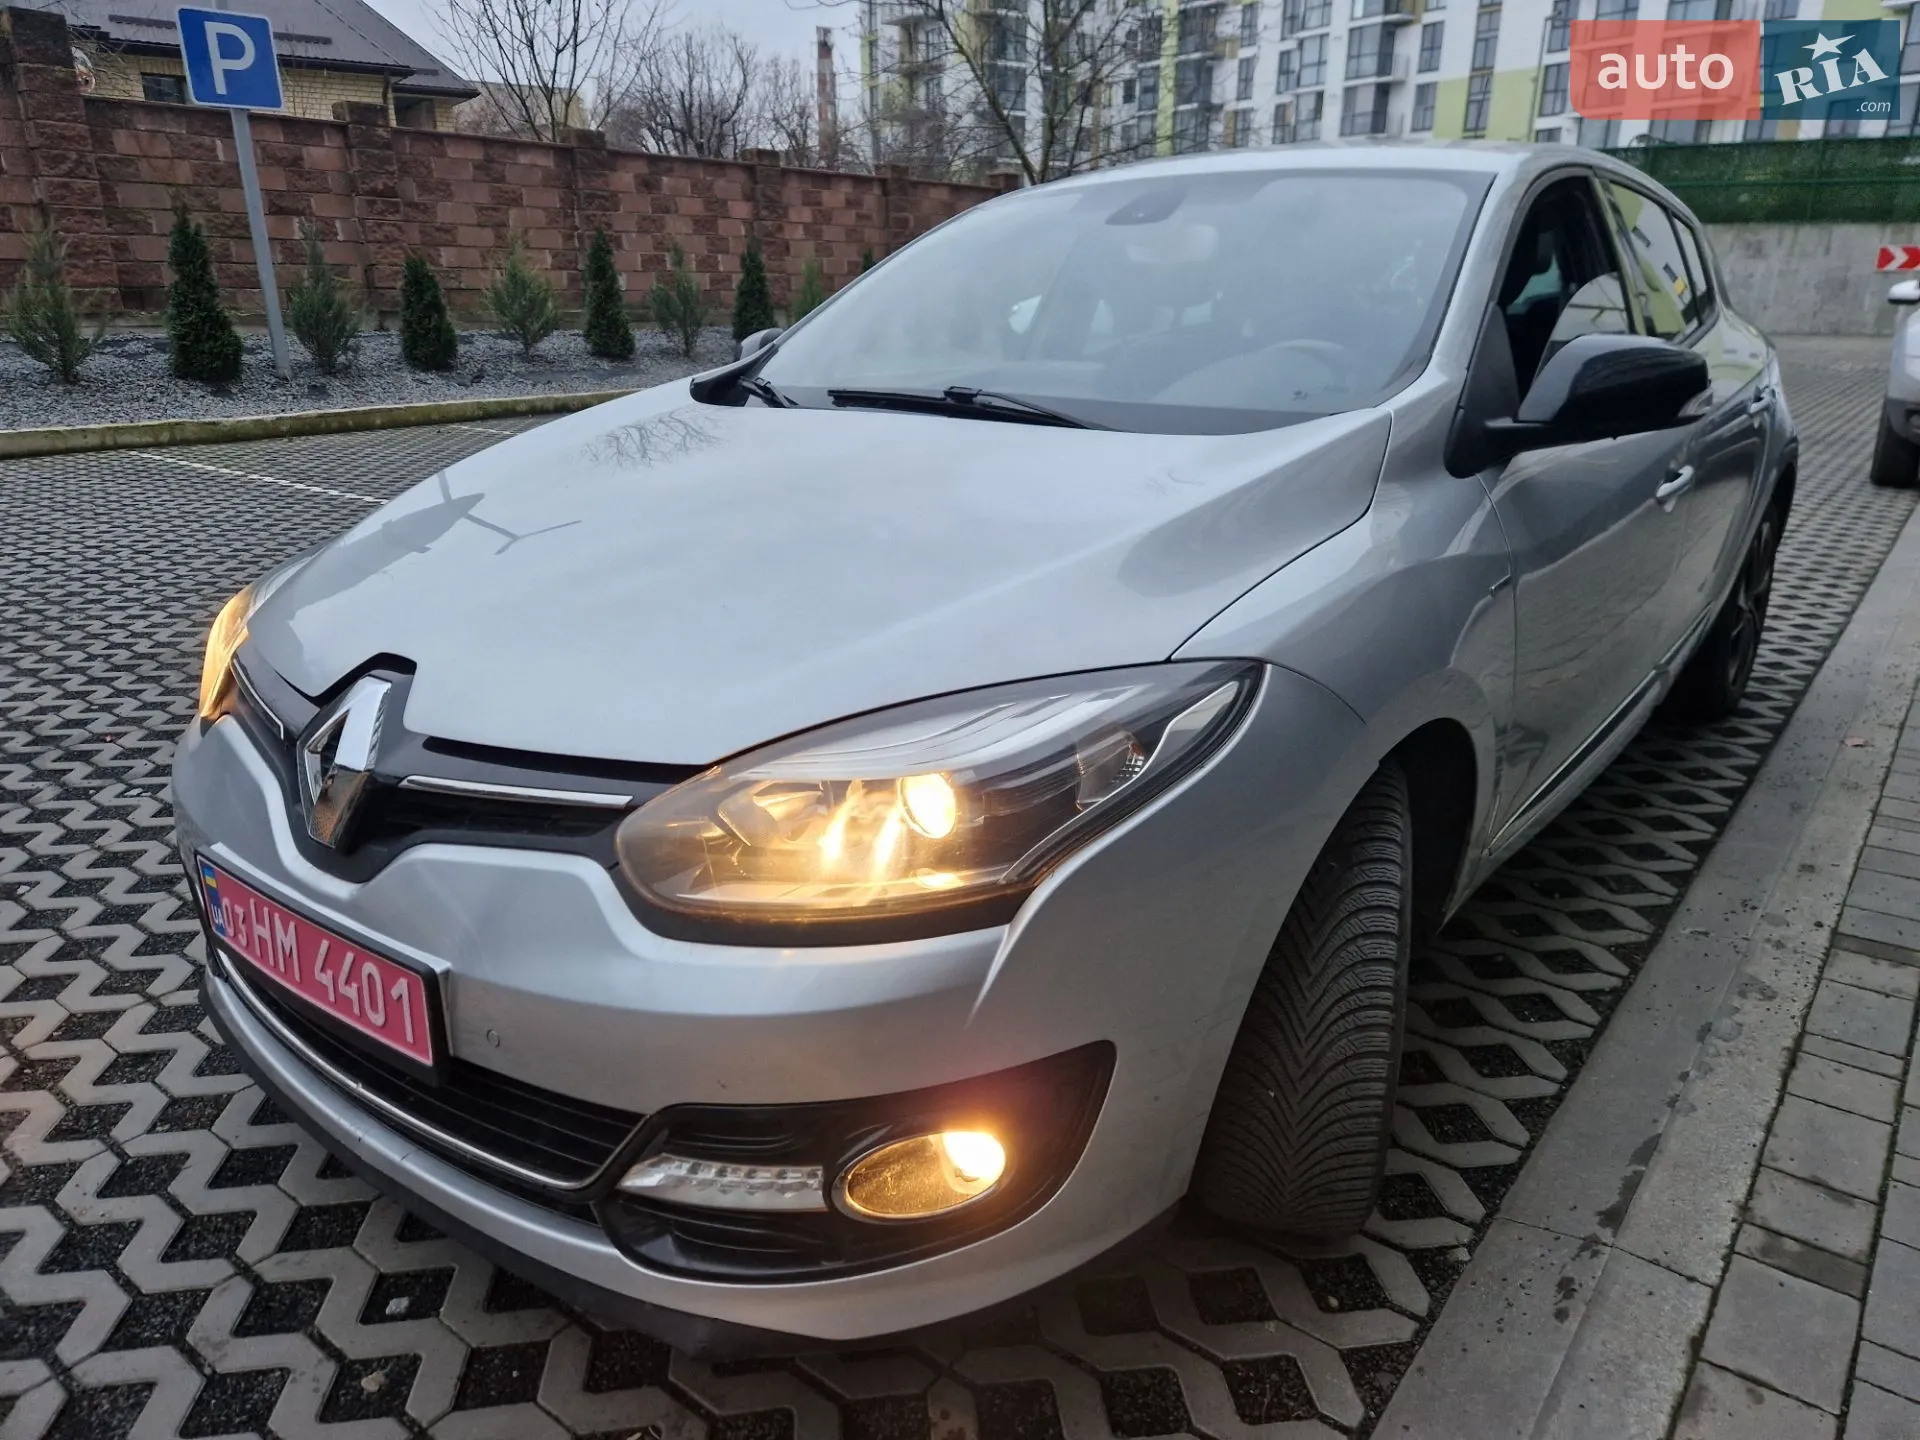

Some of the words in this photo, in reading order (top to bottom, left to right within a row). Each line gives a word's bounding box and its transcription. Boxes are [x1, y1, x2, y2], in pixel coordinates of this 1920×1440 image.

[204, 21, 255, 95] P
[211, 903, 225, 929] UA
[314, 939, 414, 1045] 4401
